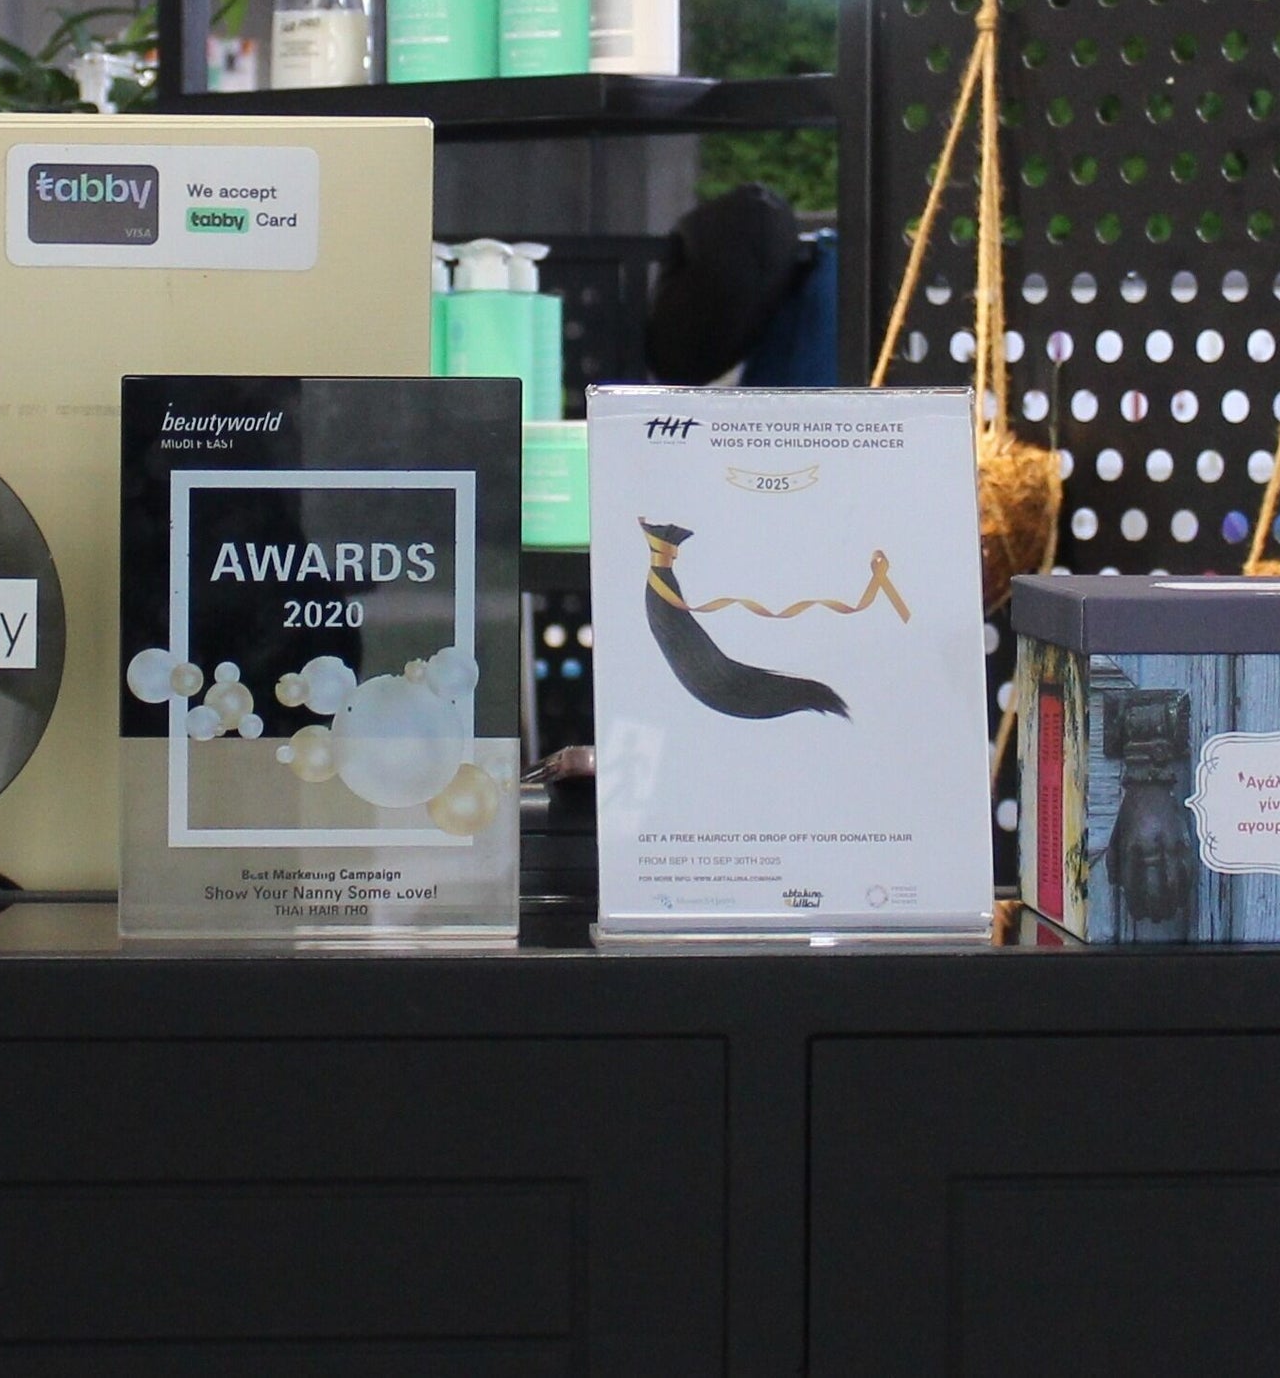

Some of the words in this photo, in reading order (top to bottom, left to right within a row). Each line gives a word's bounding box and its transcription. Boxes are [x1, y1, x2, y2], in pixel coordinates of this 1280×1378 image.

[35, 171, 152, 209] tabby
[186, 183, 213, 198] We
[218, 186, 278, 201] accept
[190, 210, 245, 231] tabby
[255, 212, 298, 228] Card
[124, 228, 152, 238] VISA
[161, 411, 283, 437] beautyworld
[711, 422, 763, 433] DONATE
[765, 422, 801, 433] YOUR
[803, 423, 833, 433] HAIR
[835, 423, 853, 433] TO
[856, 423, 904, 433] CREATE
[711, 438, 745, 448] WIGS
[747, 438, 771, 448] FOR
[774, 439, 850, 449] CHILDHOOD
[852, 439, 905, 449] CANCER
[756, 476, 791, 491] 2025
[209, 541, 437, 583] AWARDS
[282, 600, 364, 628] 2020
[638, 834, 658, 843] GET
[660, 834, 668, 843] A
[670, 834, 695, 843] FREE
[697, 834, 740, 843] HAIRCUT
[742, 834, 758, 843] OR
[759, 834, 787, 843] DROP
[789, 834, 809, 843] OFF
[811, 834, 838, 843] YOUR
[839, 834, 887, 843] DONATED
[888, 834, 913, 843] HAIR
[638, 857, 667, 865] FROM
[669, 857, 689, 865] SEP
[698, 857, 711, 865] TO
[713, 857, 733, 865] SEP
[339, 868, 402, 882] Campaign
[204, 886, 248, 900] Show
[253, 886, 288, 900] Your
[293, 886, 343, 902] Nanny
[348, 885, 391, 900] Some
[309, 905, 340, 916] HAIR
